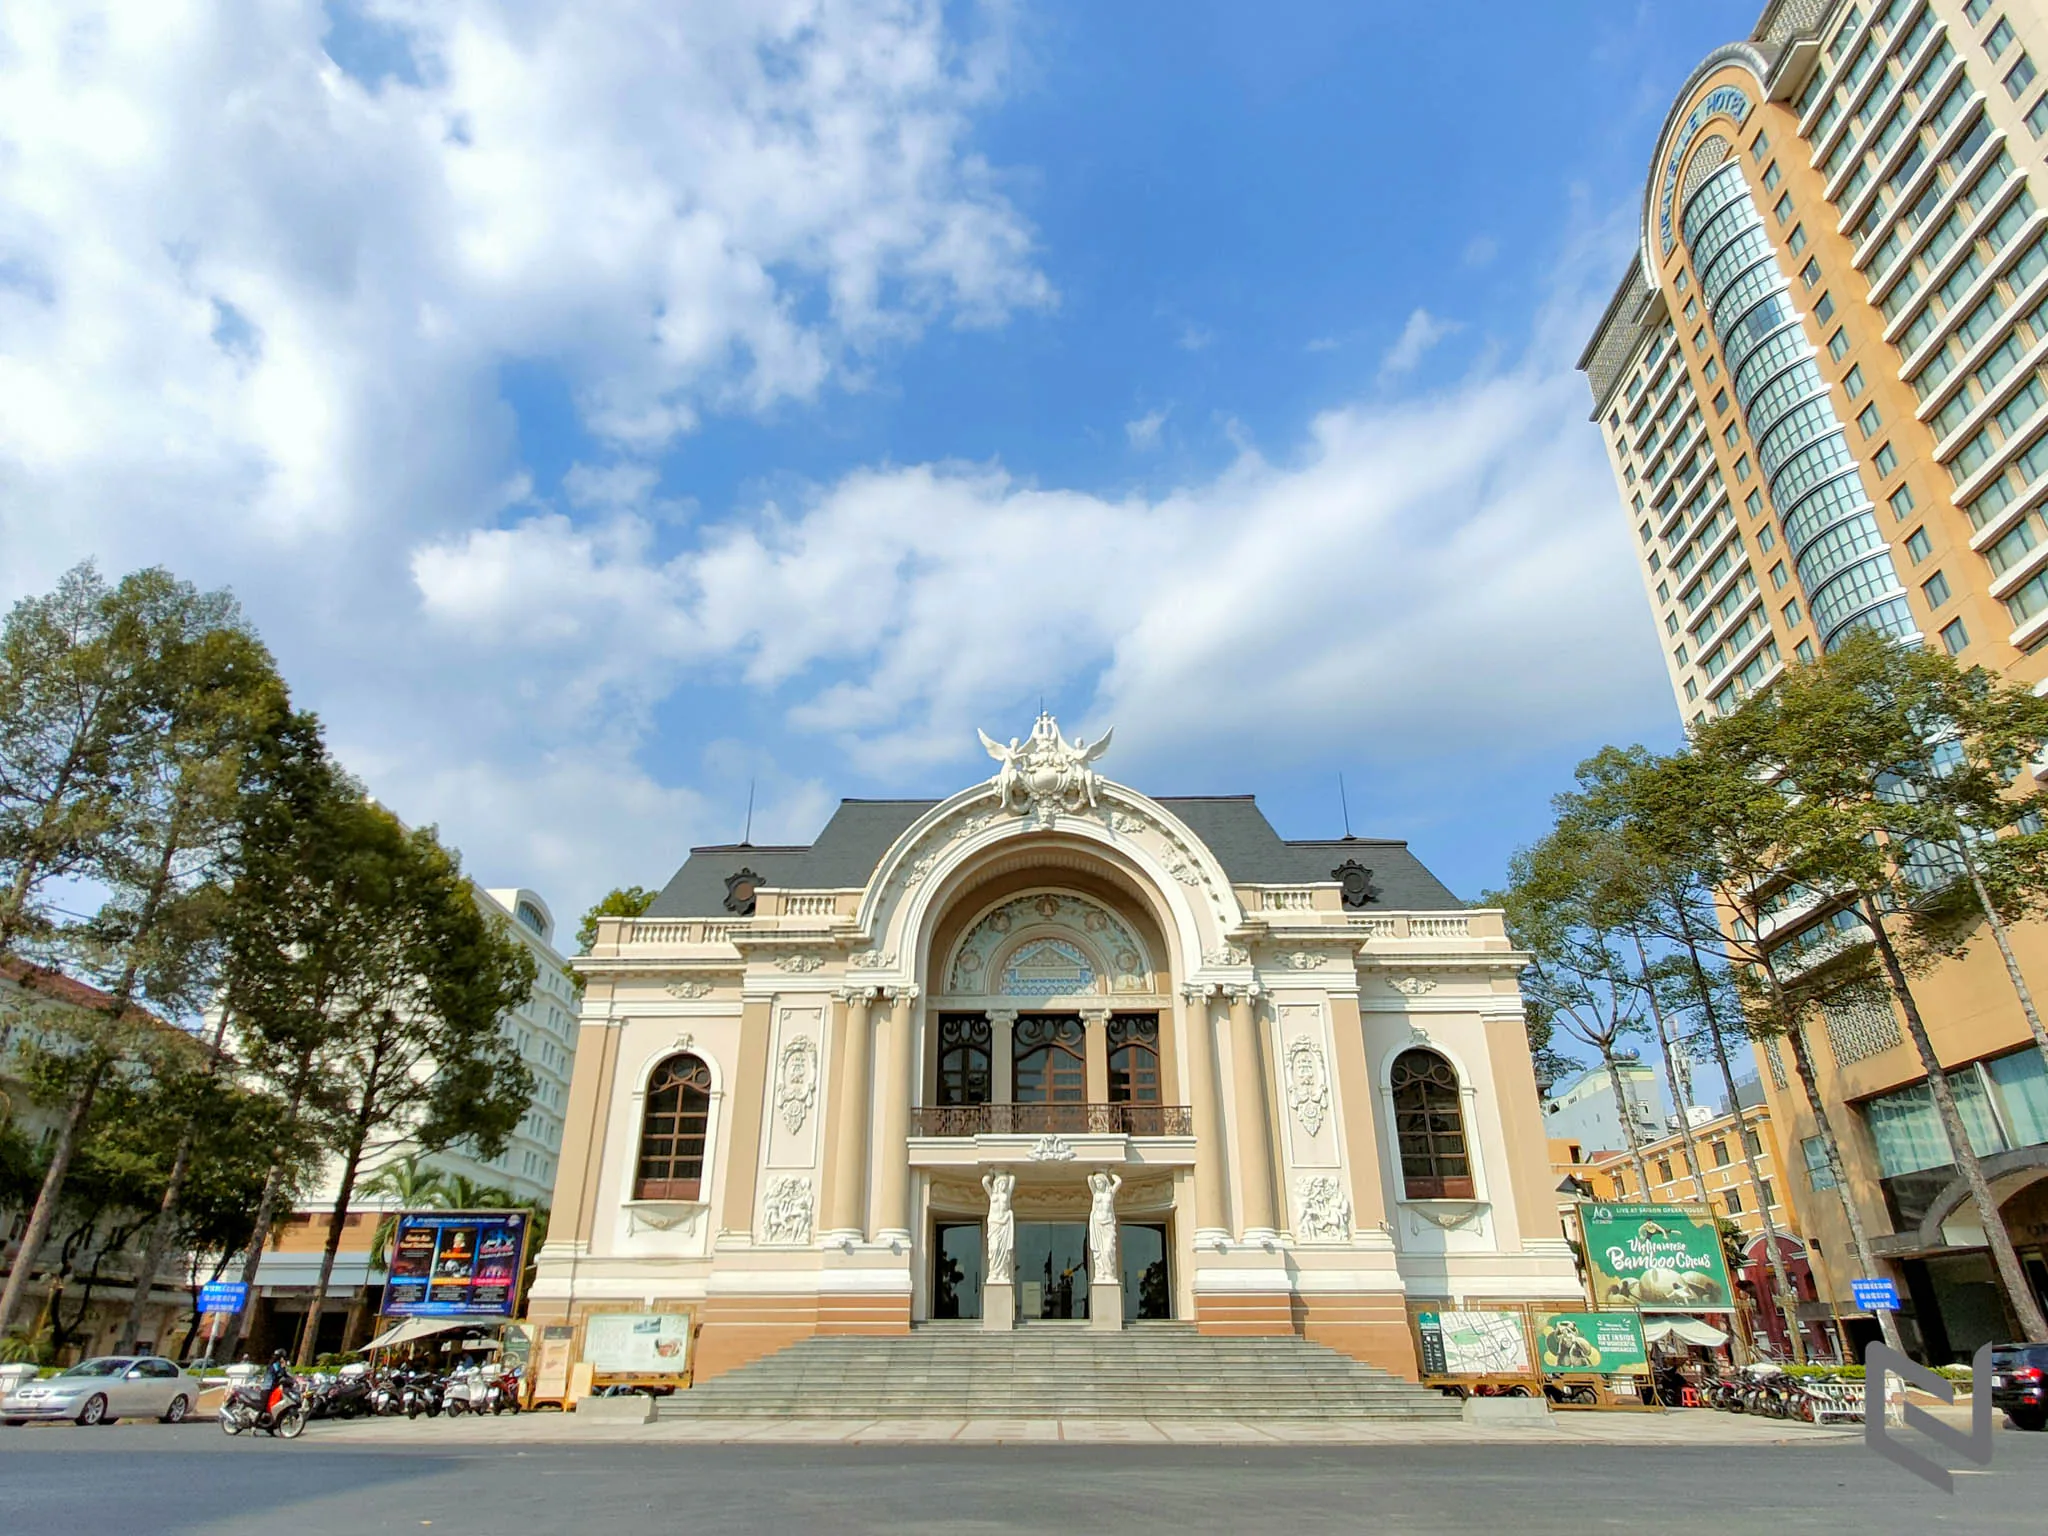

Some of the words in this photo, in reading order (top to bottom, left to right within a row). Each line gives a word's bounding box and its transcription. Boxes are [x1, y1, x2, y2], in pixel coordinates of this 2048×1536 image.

[1706, 91, 1746, 122] HOTEL
[1605, 1246, 1675, 1271] Bamboo
[1675, 1252, 1711, 1269] Circus
